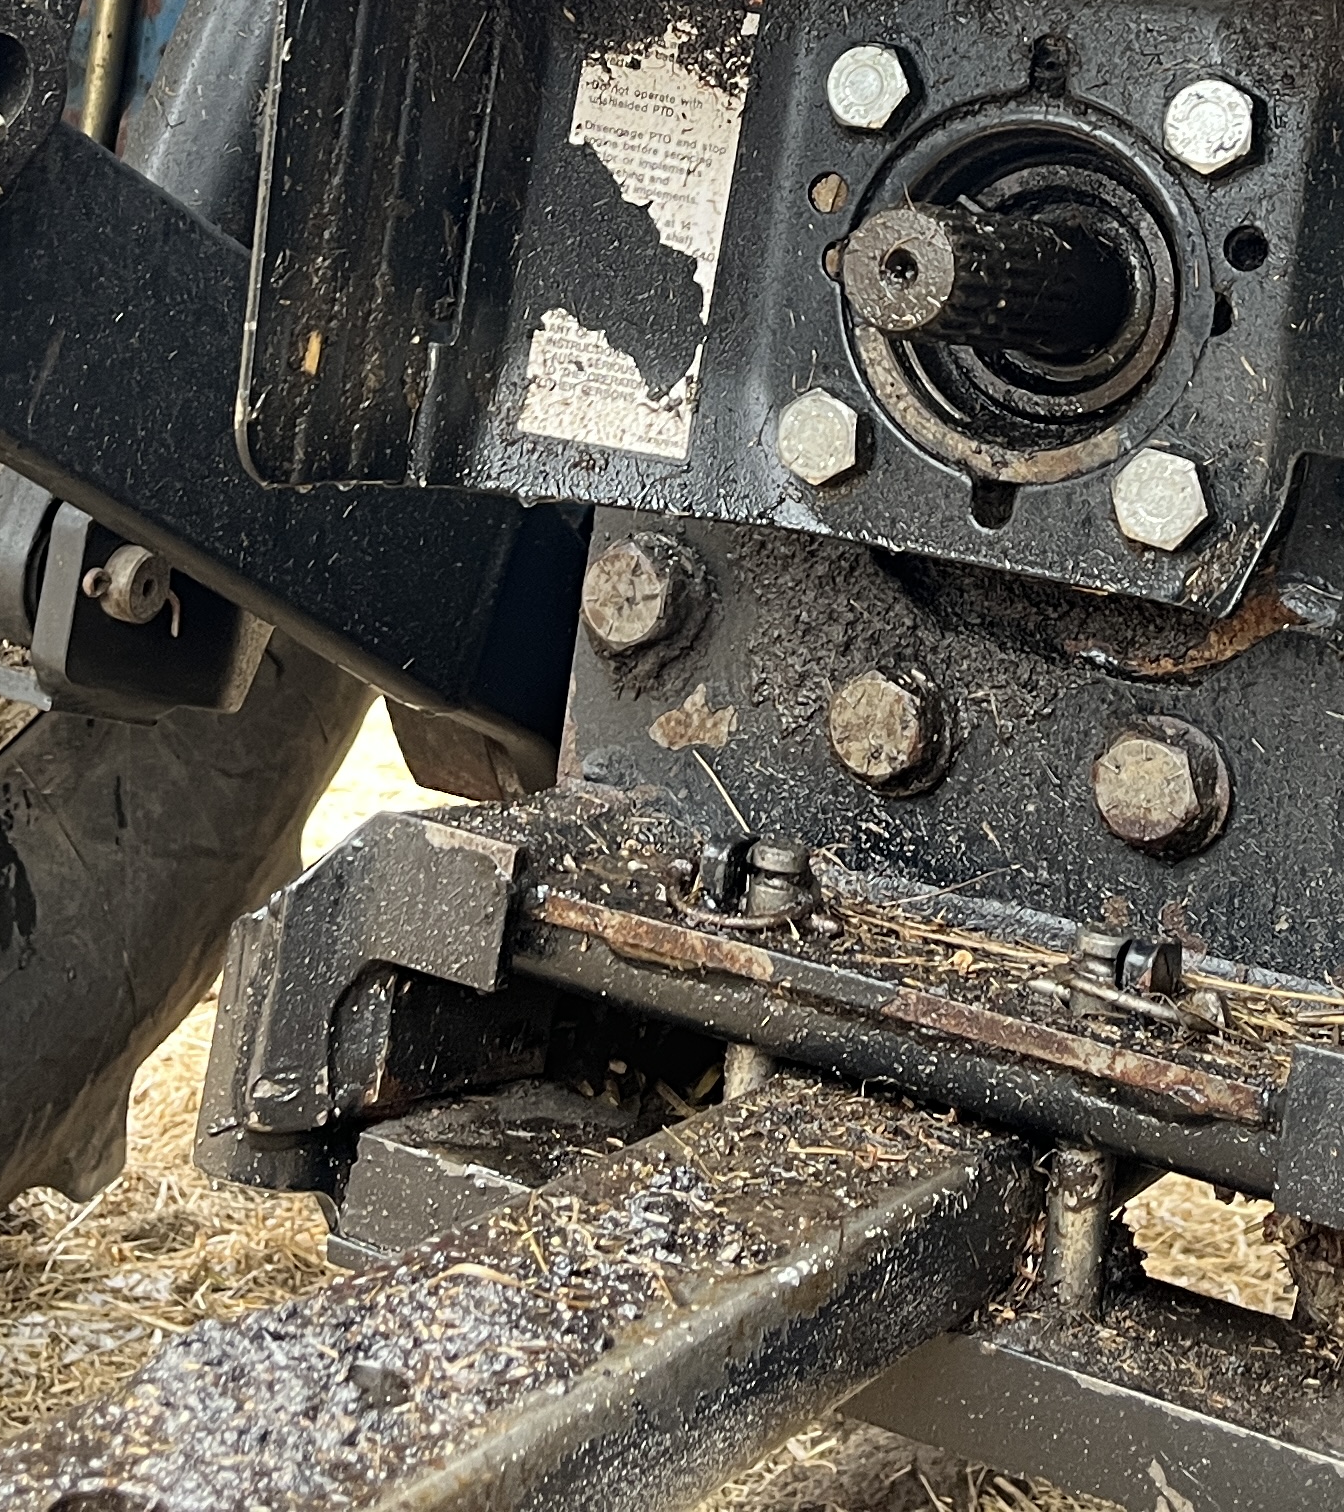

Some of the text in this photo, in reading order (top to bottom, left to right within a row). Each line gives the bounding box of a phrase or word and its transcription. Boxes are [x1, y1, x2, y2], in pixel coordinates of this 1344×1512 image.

[611, 82, 630, 95] not
[633, 89, 675, 105] operate
[680, 95, 703, 109] with
[583, 120, 727, 157] Disengage PTO and stop
[622, 140, 657, 155] before
[648, 173, 669, 186] and
